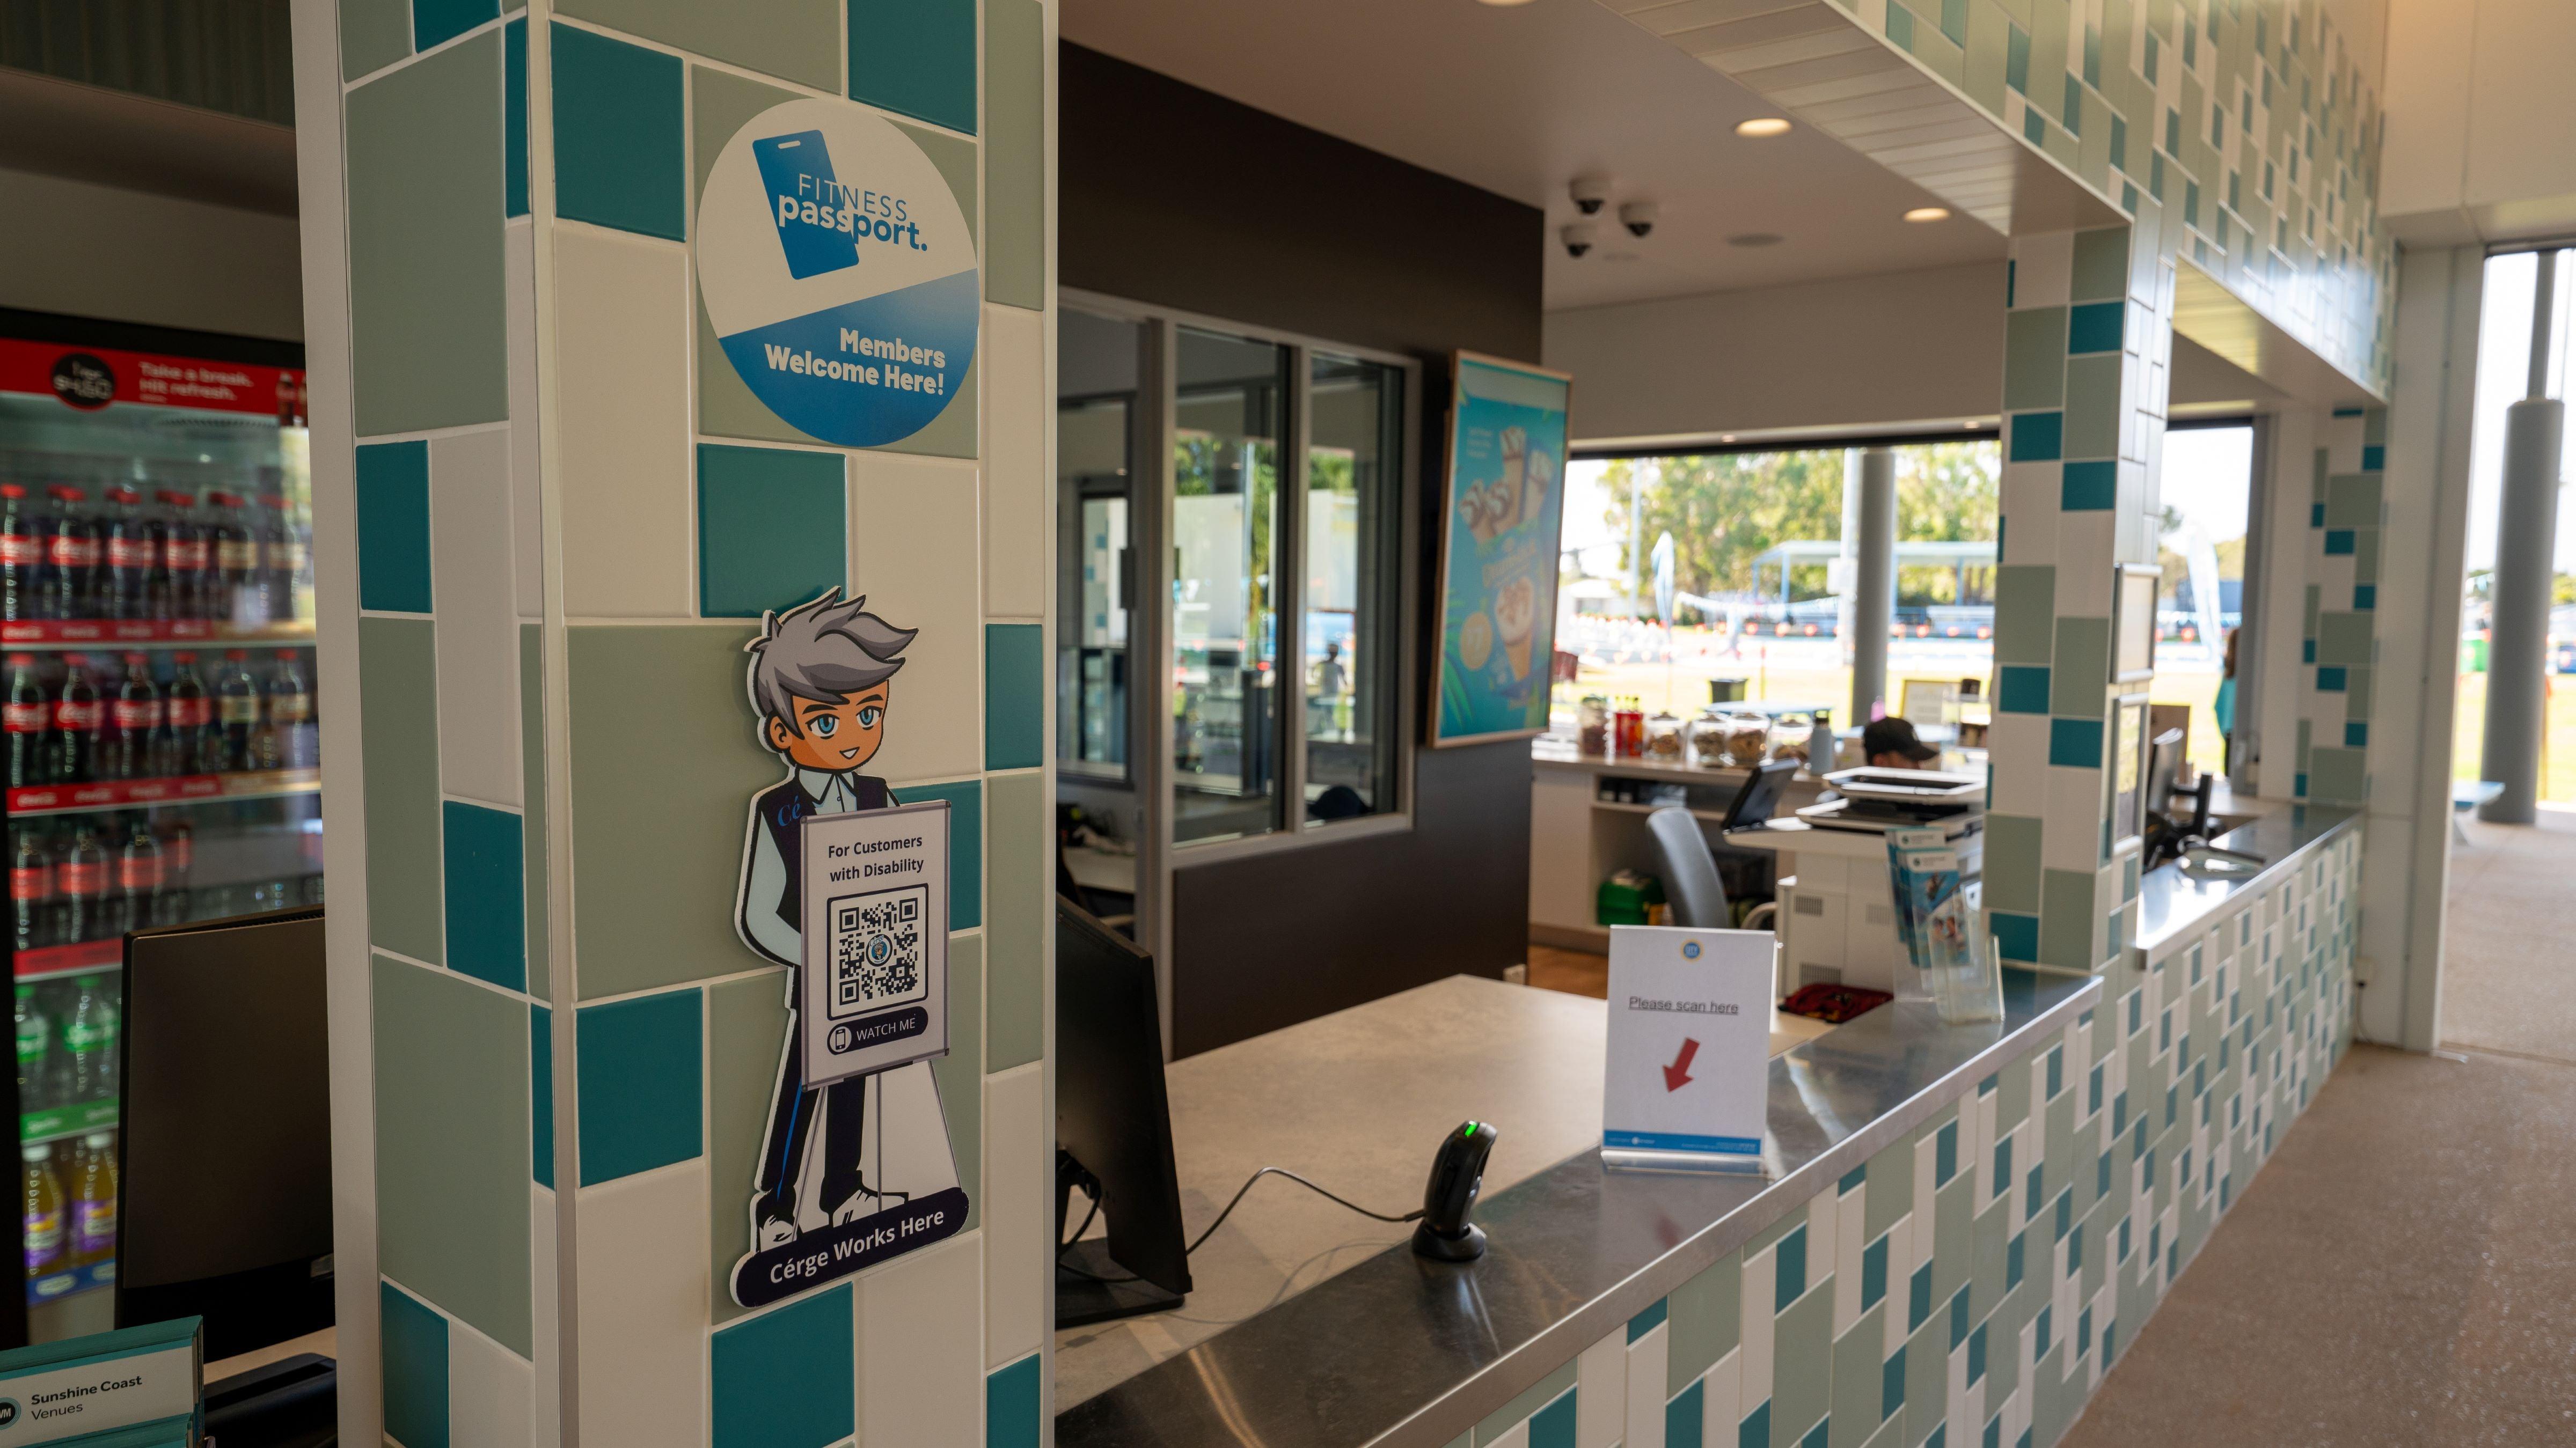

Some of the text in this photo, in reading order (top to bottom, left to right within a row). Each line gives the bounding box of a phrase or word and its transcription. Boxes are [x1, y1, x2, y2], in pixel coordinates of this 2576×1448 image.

[799, 173, 908, 222] FITNESS
[779, 194, 928, 252] passport.
[840, 327, 946, 369] Members
[764, 343, 944, 395] Welcome Here!
[828, 835, 923, 858] For Customers
[830, 858, 924, 882] with Disability
[1628, 996, 1739, 1016] Please scan here
[857, 1018, 916, 1041] WATCH ME
[770, 1210, 944, 1284] Cérge Works Here
[31, 1375, 143, 1405] Sunshine Coast
[31, 1403, 83, 1420] Venues
